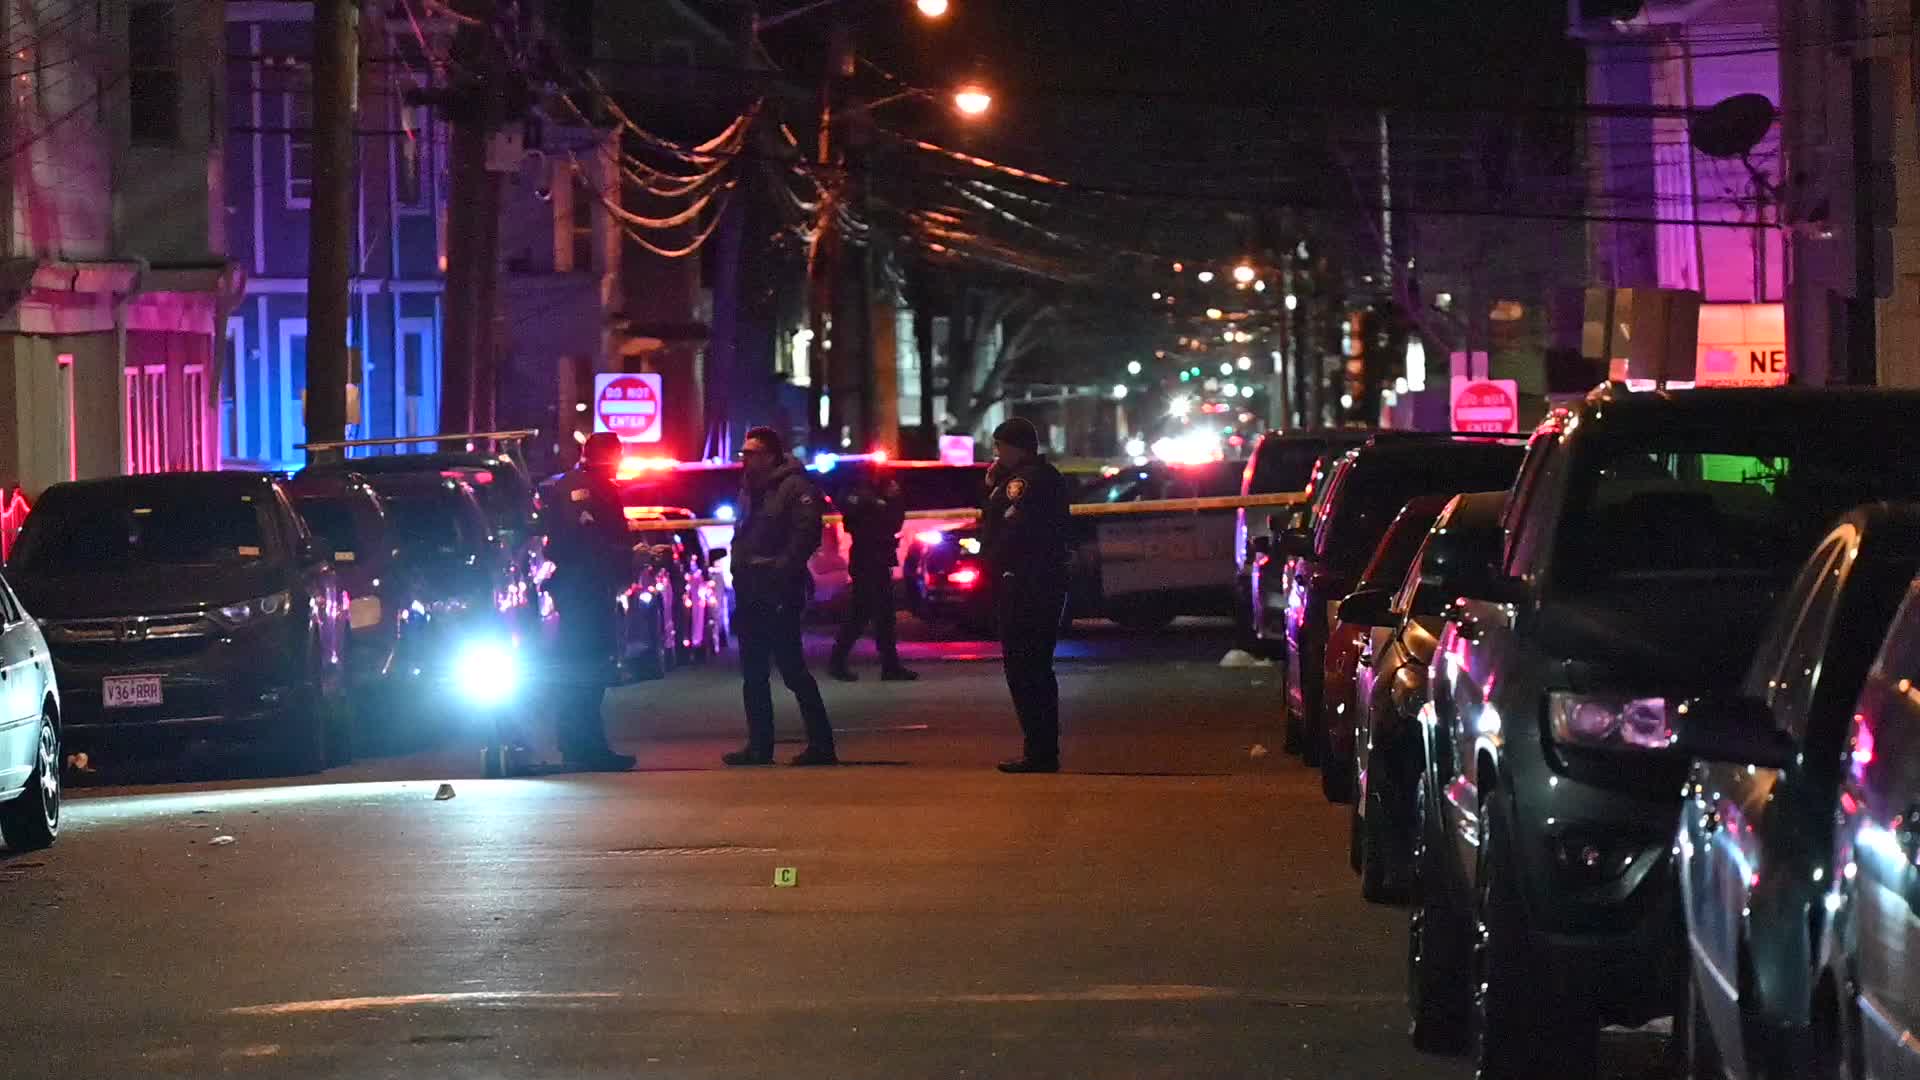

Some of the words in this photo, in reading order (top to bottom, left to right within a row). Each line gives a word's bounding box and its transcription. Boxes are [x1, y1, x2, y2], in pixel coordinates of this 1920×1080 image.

[605, 387, 622, 399] DO
[626, 387, 649, 399] NOT
[609, 415, 645, 428] ENTER
[782, 869, 790, 882] C
